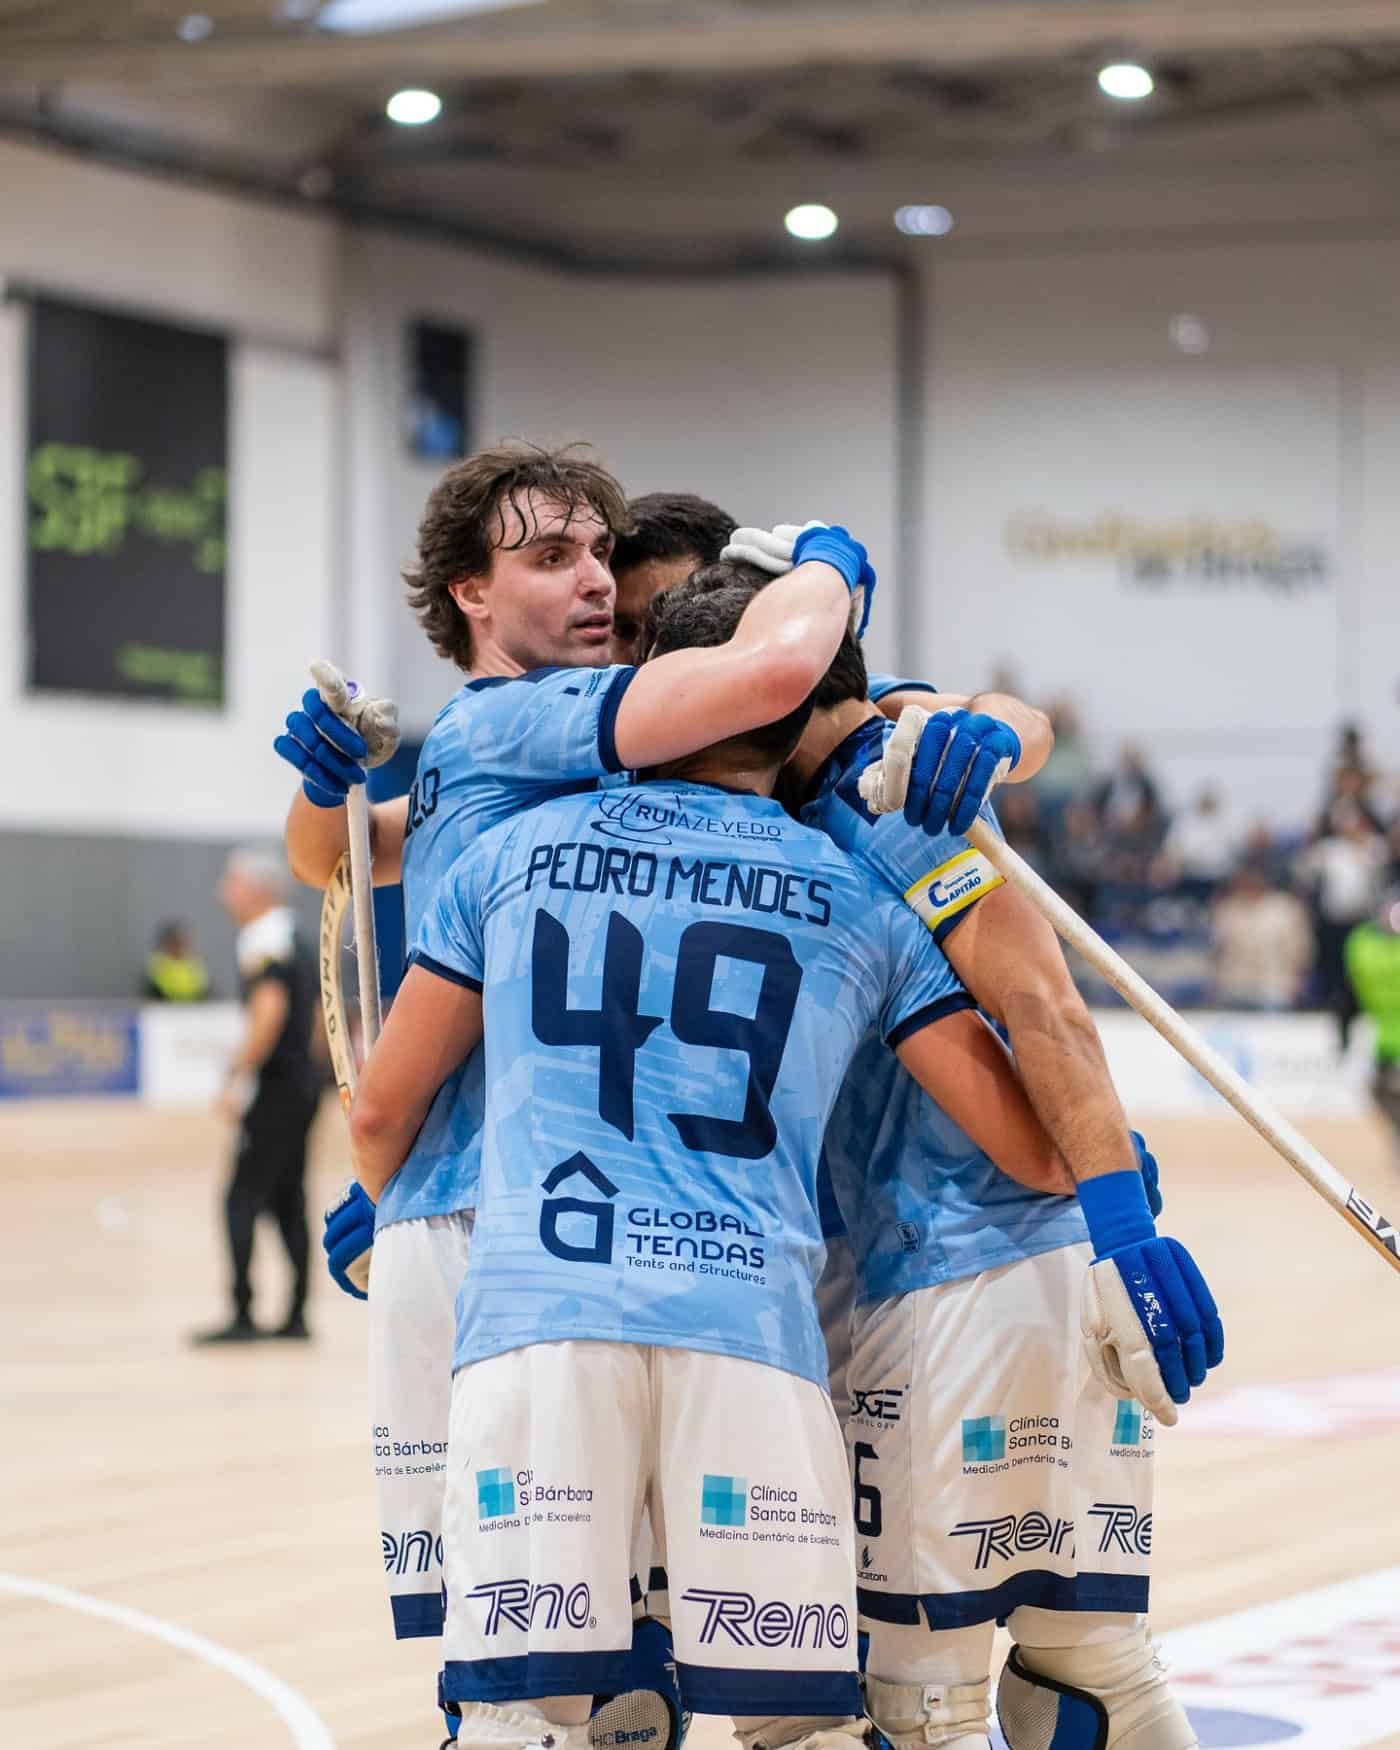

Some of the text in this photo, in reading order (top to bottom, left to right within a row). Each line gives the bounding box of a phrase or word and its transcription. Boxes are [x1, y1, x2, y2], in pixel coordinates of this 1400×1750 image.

[525, 843, 834, 927] PEDRO MENDES
[532, 908, 803, 1160] 49
[628, 1208, 765, 1238] GLOBAL
[627, 1234, 765, 1269] TENDAS
[626, 1256, 767, 1285] Tents and Structures
[1009, 1416, 1060, 1432] Clínica
[1008, 1433, 1073, 1450] Santa B
[963, 1461, 1009, 1474] Medicina
[1012, 1453, 1055, 1467] Dentária
[750, 1486, 798, 1502] Clínica
[854, 1441, 882, 1537] 6
[750, 1506, 796, 1522] Santa
[699, 1528, 749, 1541] Medicina
[752, 1532, 795, 1543] Dentária
[465, 1578, 591, 1636] Rno
[680, 1588, 849, 1649] Reno
